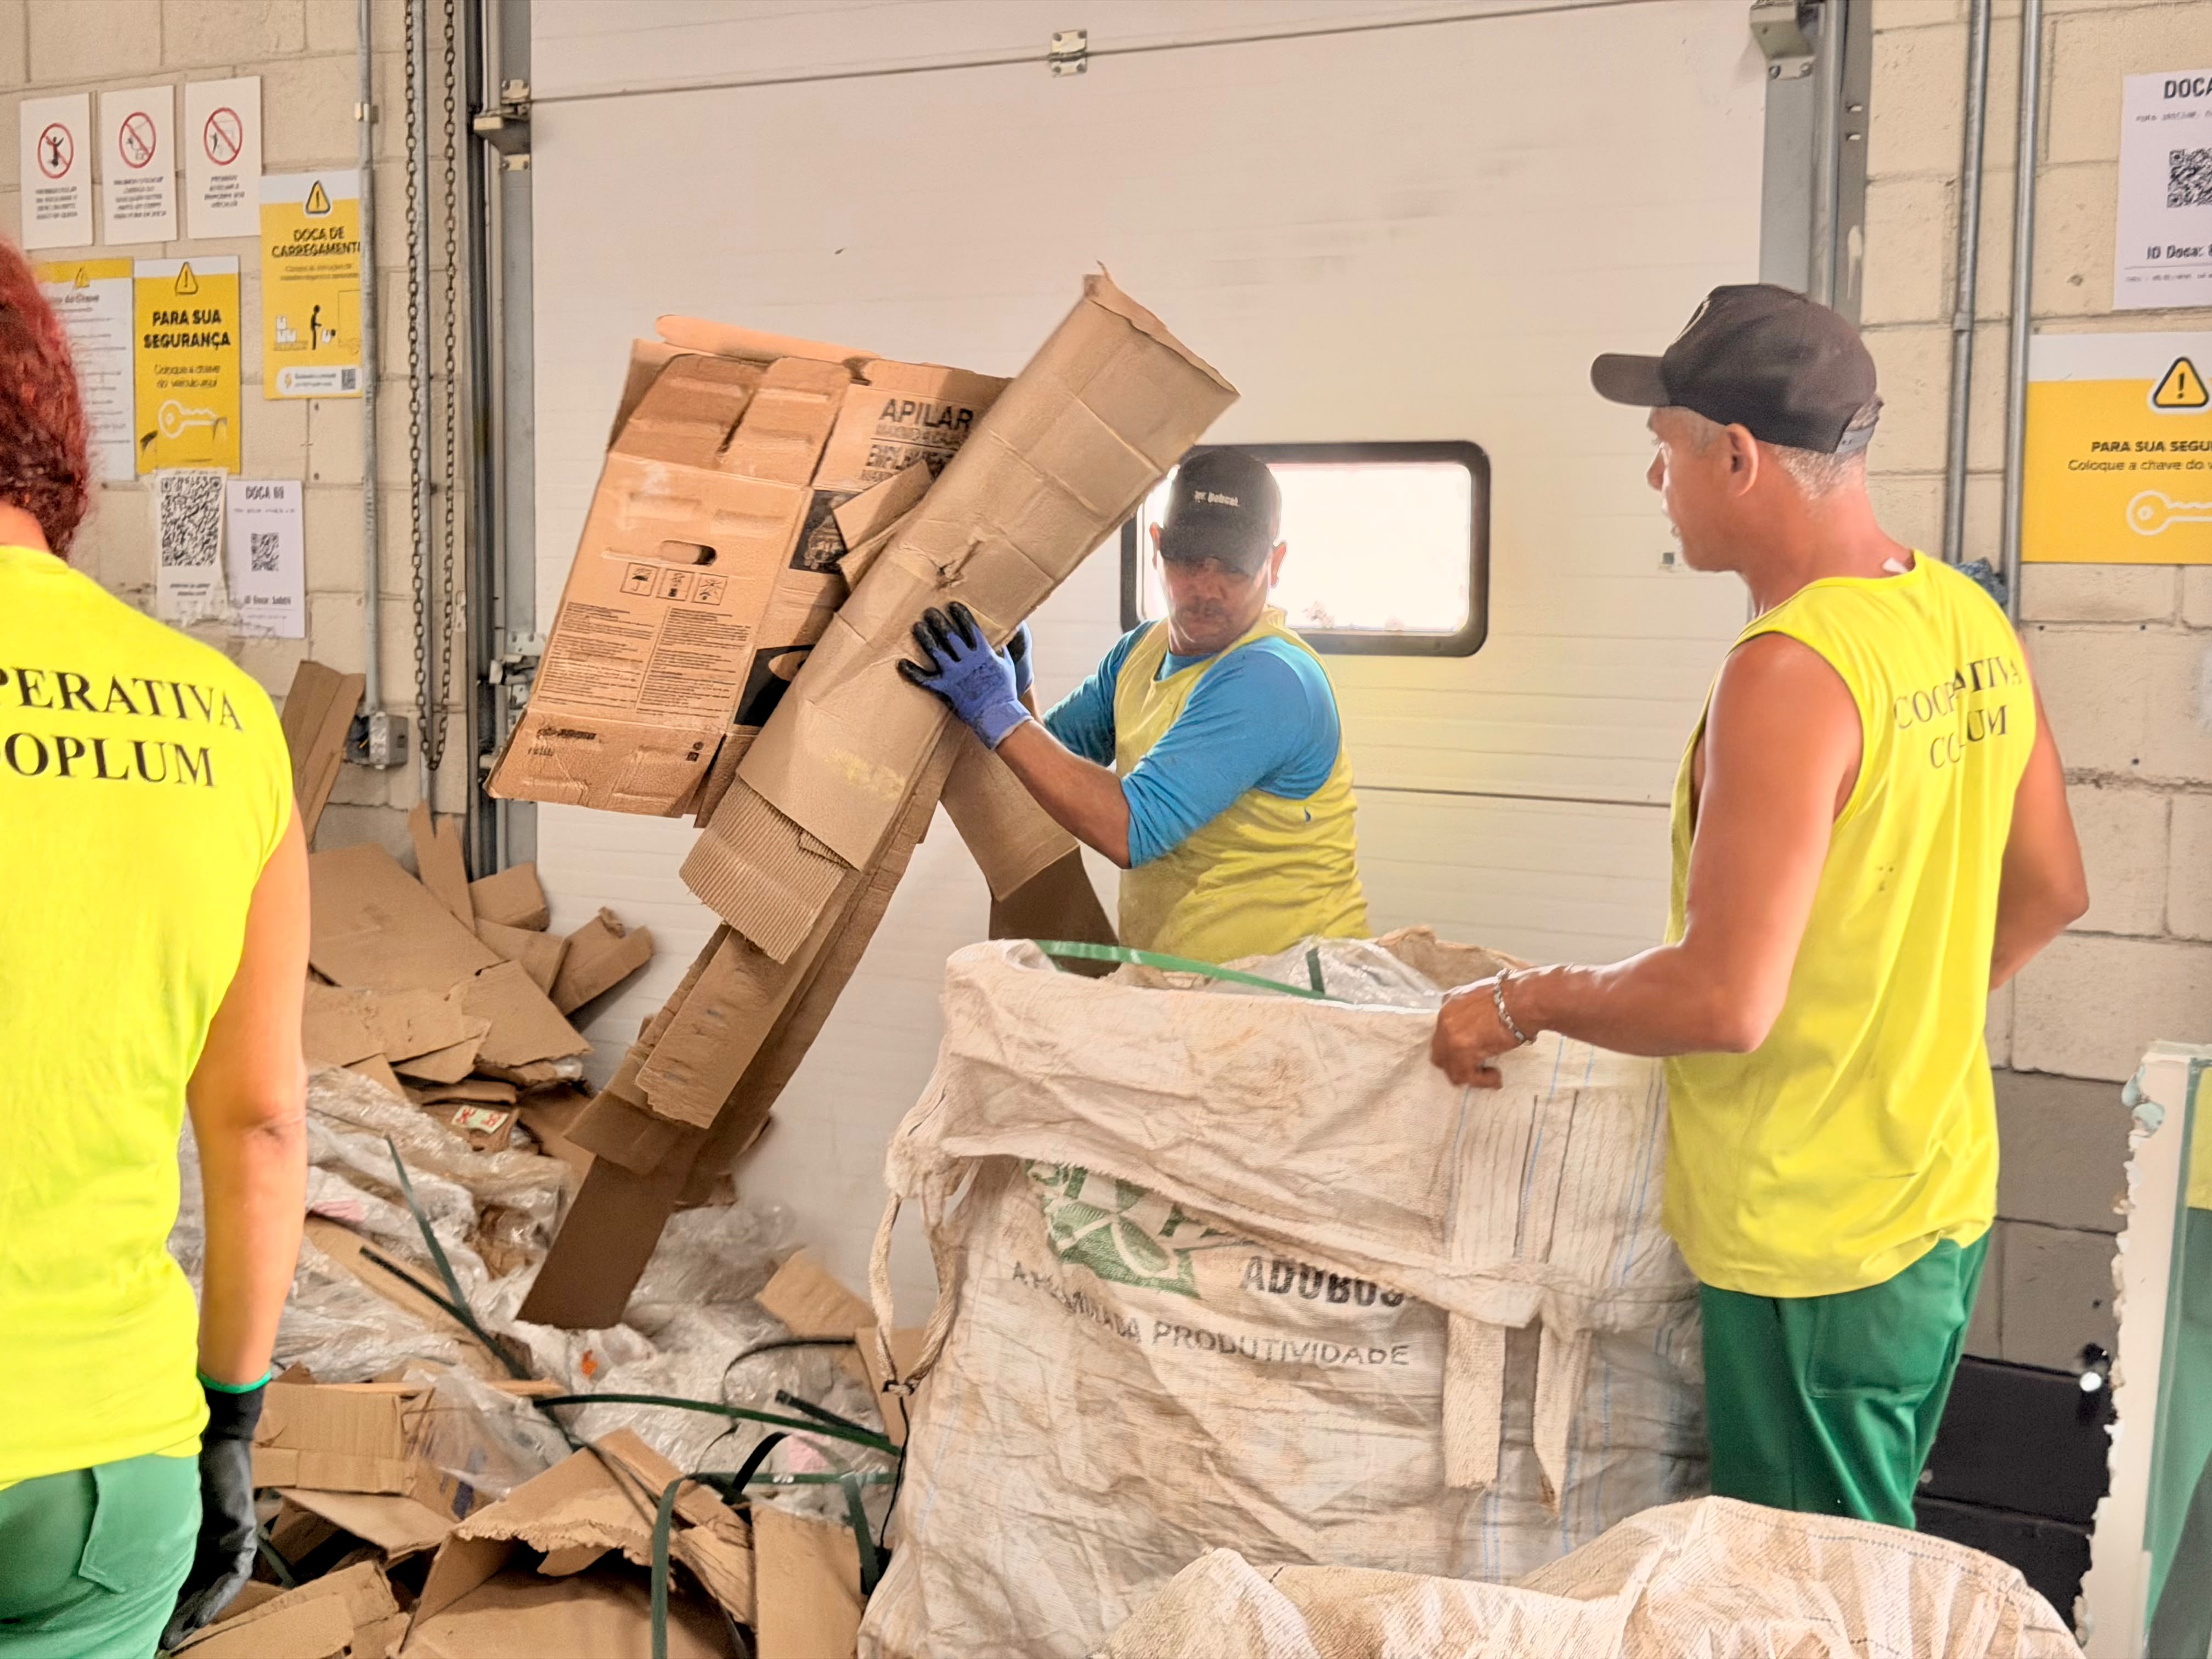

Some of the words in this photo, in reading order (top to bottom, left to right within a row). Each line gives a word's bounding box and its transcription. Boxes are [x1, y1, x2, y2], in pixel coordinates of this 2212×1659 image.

[294, 228, 328, 241] DOCA
[329, 225, 345, 239] DE
[272, 241, 360, 258] CARREGAMENT
[153, 310, 189, 326] PARA
[193, 309, 222, 325] SUA
[144, 331, 231, 351] SEGURANÇA
[879, 398, 974, 432] APILAR
[2091, 441, 2131, 452] PARA
[2135, 441, 2165, 452] SUA
[2170, 441, 2212, 452] SEGU
[2068, 459, 2125, 472] Coloque
[2140, 460, 2181, 470] chave
[2186, 459, 2204, 470] do
[0, 668, 243, 732] ERATIVA
[1152, 1320, 1410, 1365] PRODUTIVIDADE
